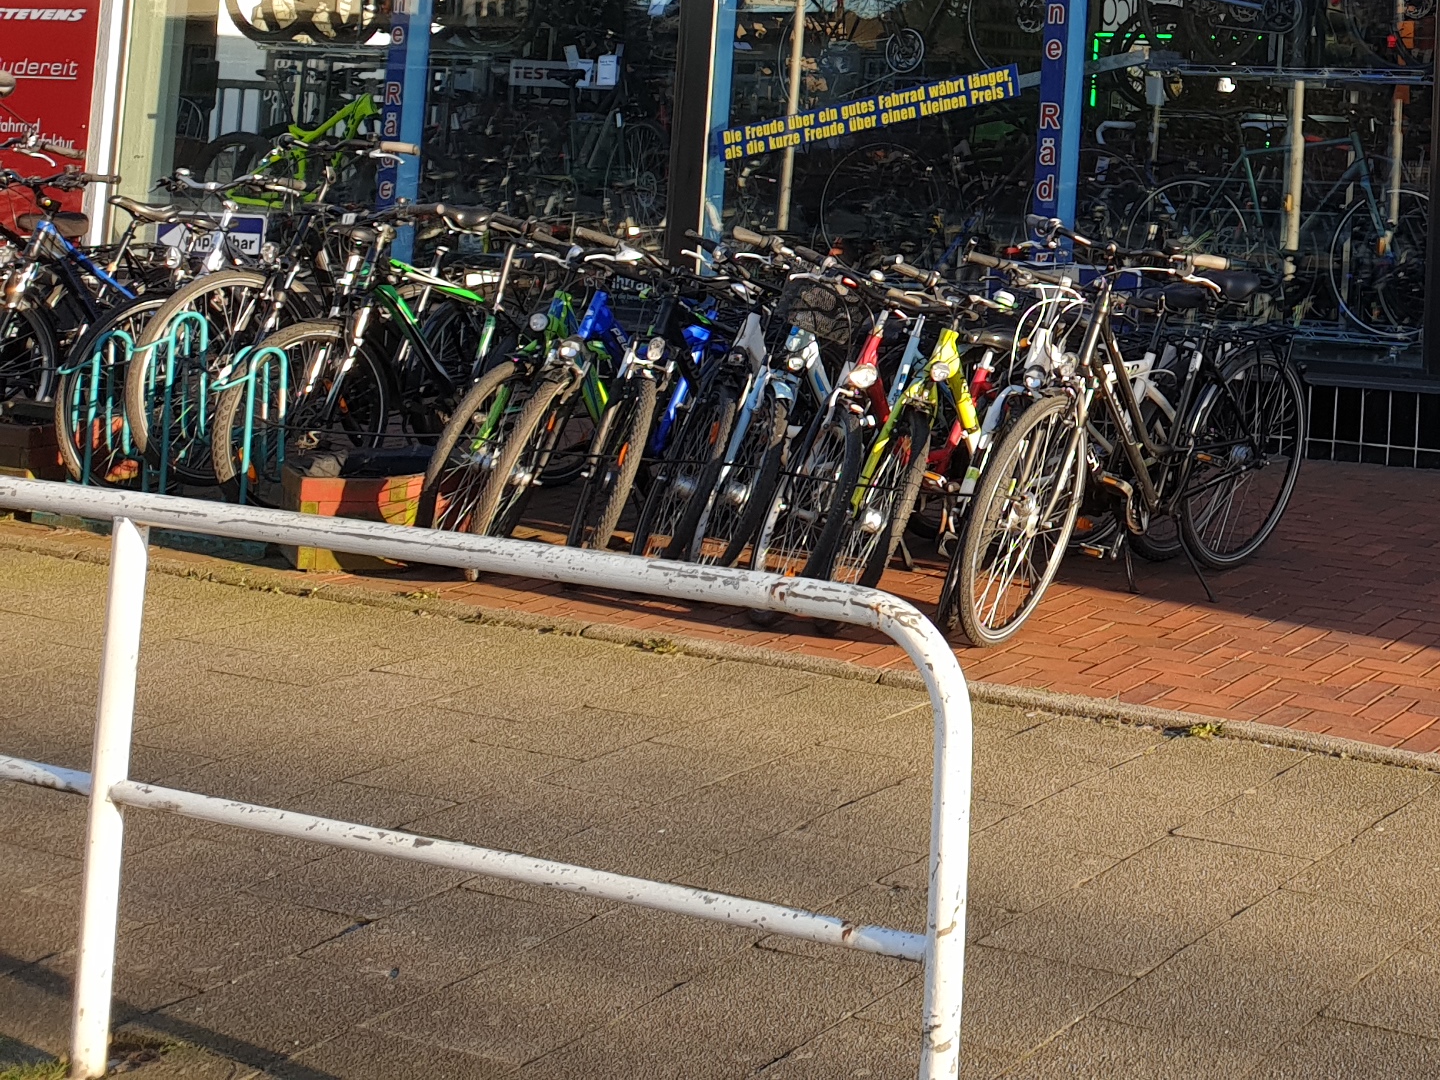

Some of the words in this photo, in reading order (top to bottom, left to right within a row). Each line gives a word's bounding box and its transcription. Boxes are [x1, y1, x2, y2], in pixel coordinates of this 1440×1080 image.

[0, 57, 78, 76] udereit
[723, 129, 743, 145] Die
[745, 119, 785, 140] Freude
[788, 113, 815, 133] über
[818, 108, 838, 123] ein
[841, 100, 876, 121] gutes
[878, 86, 926, 109] Fahrrad
[929, 77, 966, 99] währt
[968, 68, 1013, 92] länger,
[724, 144, 744, 160] als
[746, 139, 765, 155] die
[768, 131, 801, 150] kurze
[804, 123, 846, 142] Freude
[849, 113, 877, 133] über
[881, 106, 916, 127] einen
[920, 96, 968, 119] kleinen
[971, 85, 1005, 105] Preis
[1008, 83, 1014, 97] !
